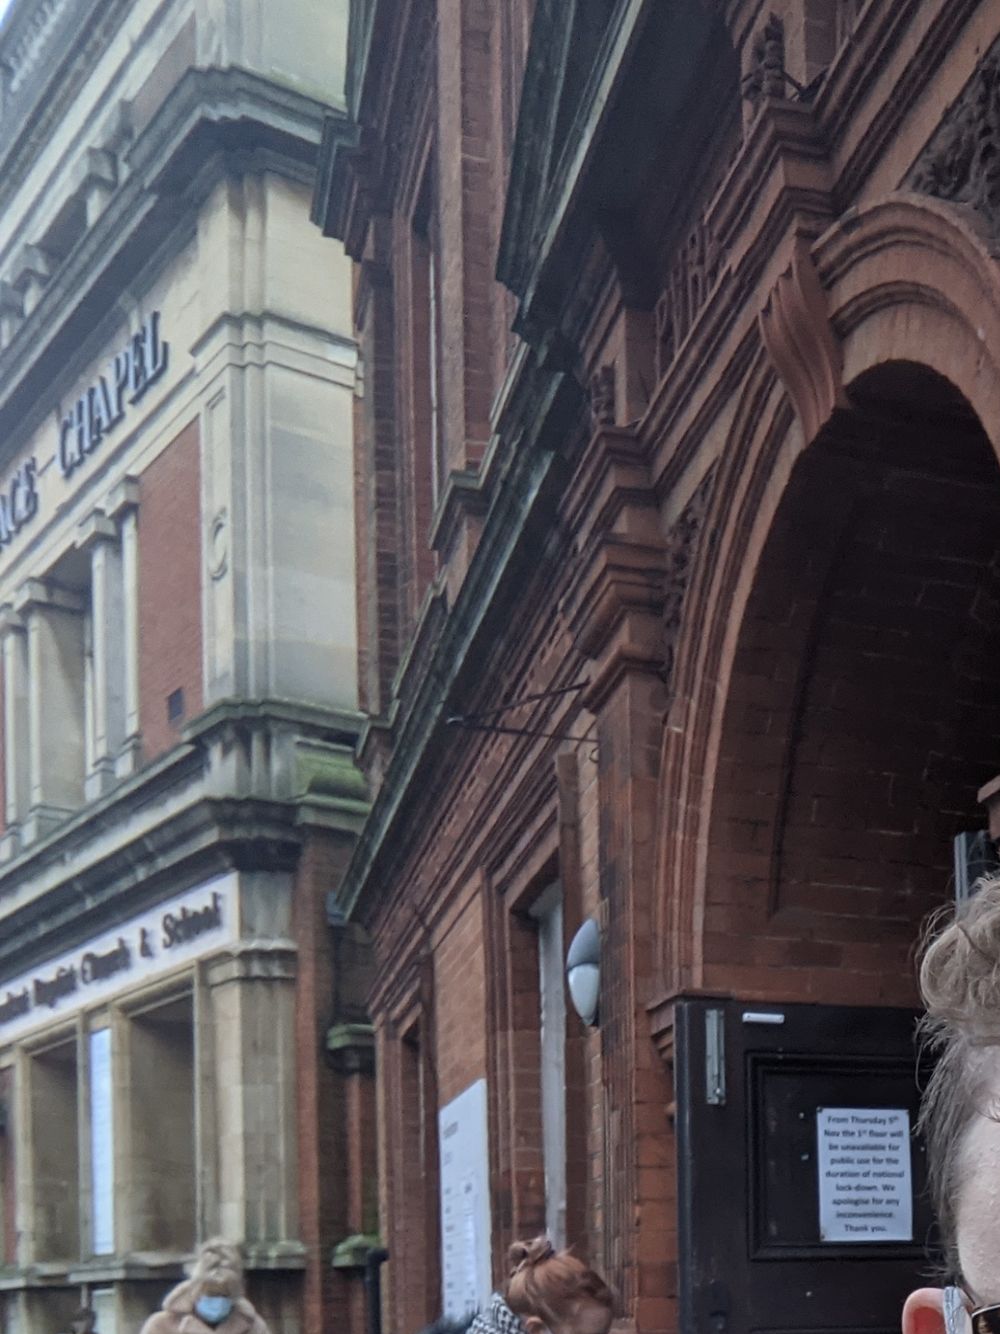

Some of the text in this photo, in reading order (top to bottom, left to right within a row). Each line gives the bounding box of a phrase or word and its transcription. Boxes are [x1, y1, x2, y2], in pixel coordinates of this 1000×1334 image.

[61, 310, 169, 478] CHAPEL
[827, 1115, 849, 1124] From
[850, 1115, 887, 1126] Thursday
[824, 1129, 840, 1137] Nov
[842, 1129, 855, 1137] the
[869, 1129, 889, 1138] floor
[890, 1130, 903, 1138] will
[829, 1143, 900, 1151] be unavailable for
[830, 1156, 854, 1165] public
[872, 1156, 884, 1165] for
[886, 1156, 899, 1165] the
[825, 1170, 904, 1178] duration of national
[832, 1197, 900, 1206] apologise for any
[844, 1224, 868, 1232] Thank
